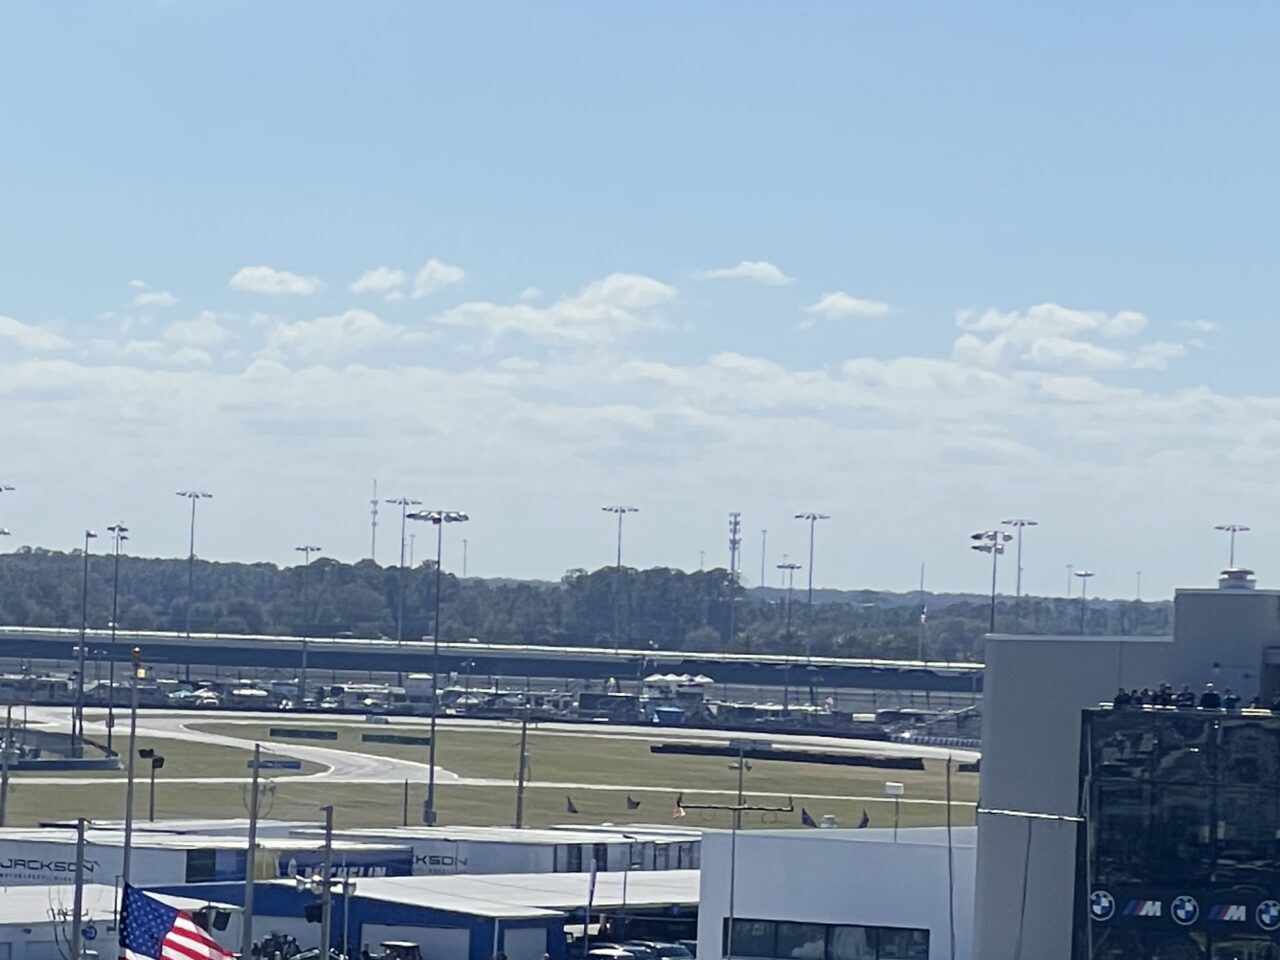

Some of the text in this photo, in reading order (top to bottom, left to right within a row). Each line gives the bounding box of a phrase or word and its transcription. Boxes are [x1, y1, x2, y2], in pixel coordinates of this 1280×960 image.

[0, 858, 94, 873] JACKSON
[415, 855, 468, 867] KSON
[304, 866, 387, 879] MCHELIN
